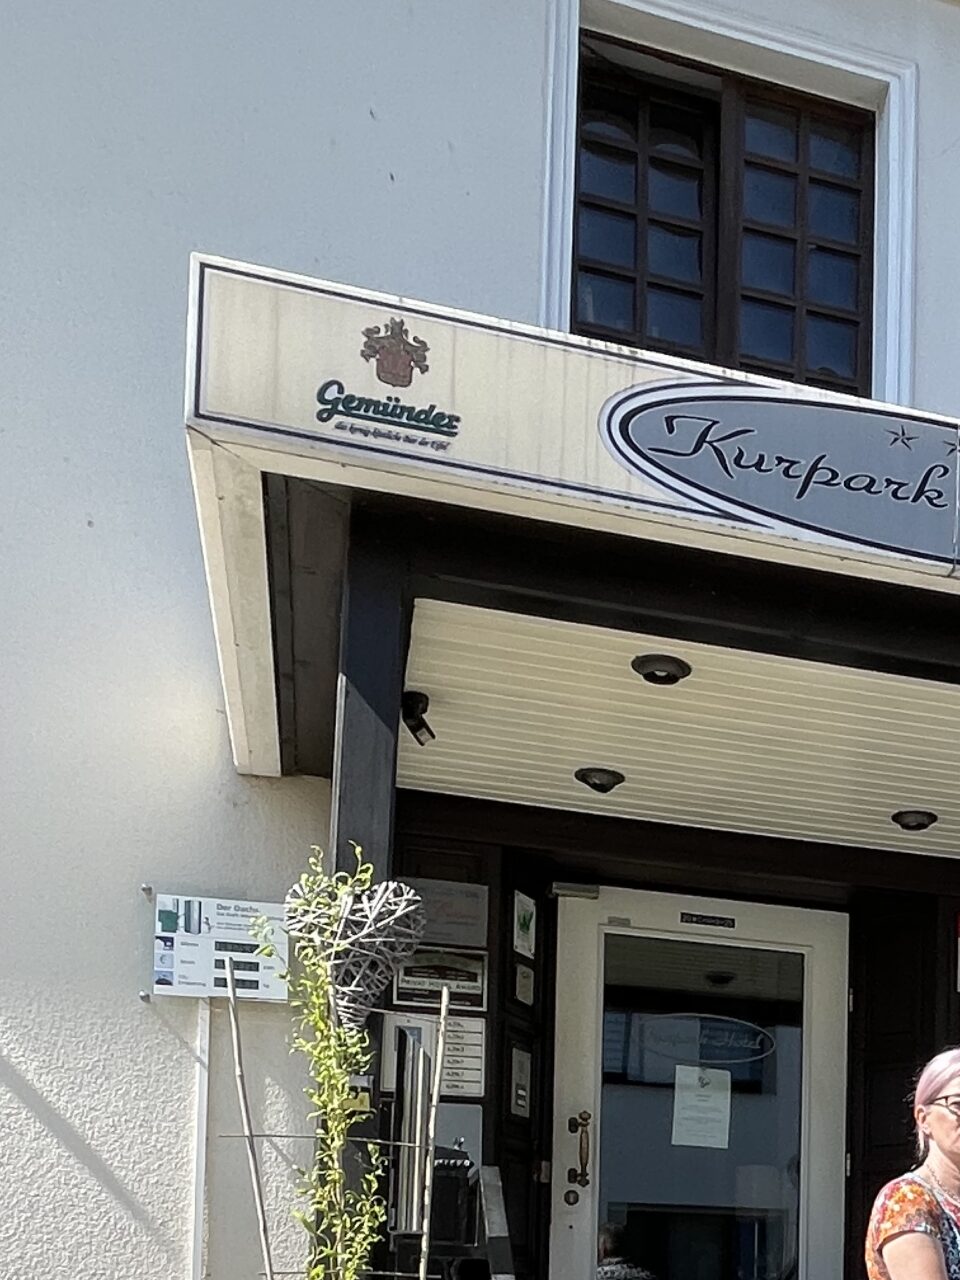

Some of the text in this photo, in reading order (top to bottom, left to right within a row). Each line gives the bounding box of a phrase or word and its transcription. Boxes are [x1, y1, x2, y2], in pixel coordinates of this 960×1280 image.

[316, 380, 461, 435] Gemünder
[647, 414, 951, 509] Kurpark
[216, 903, 232, 911] Der
